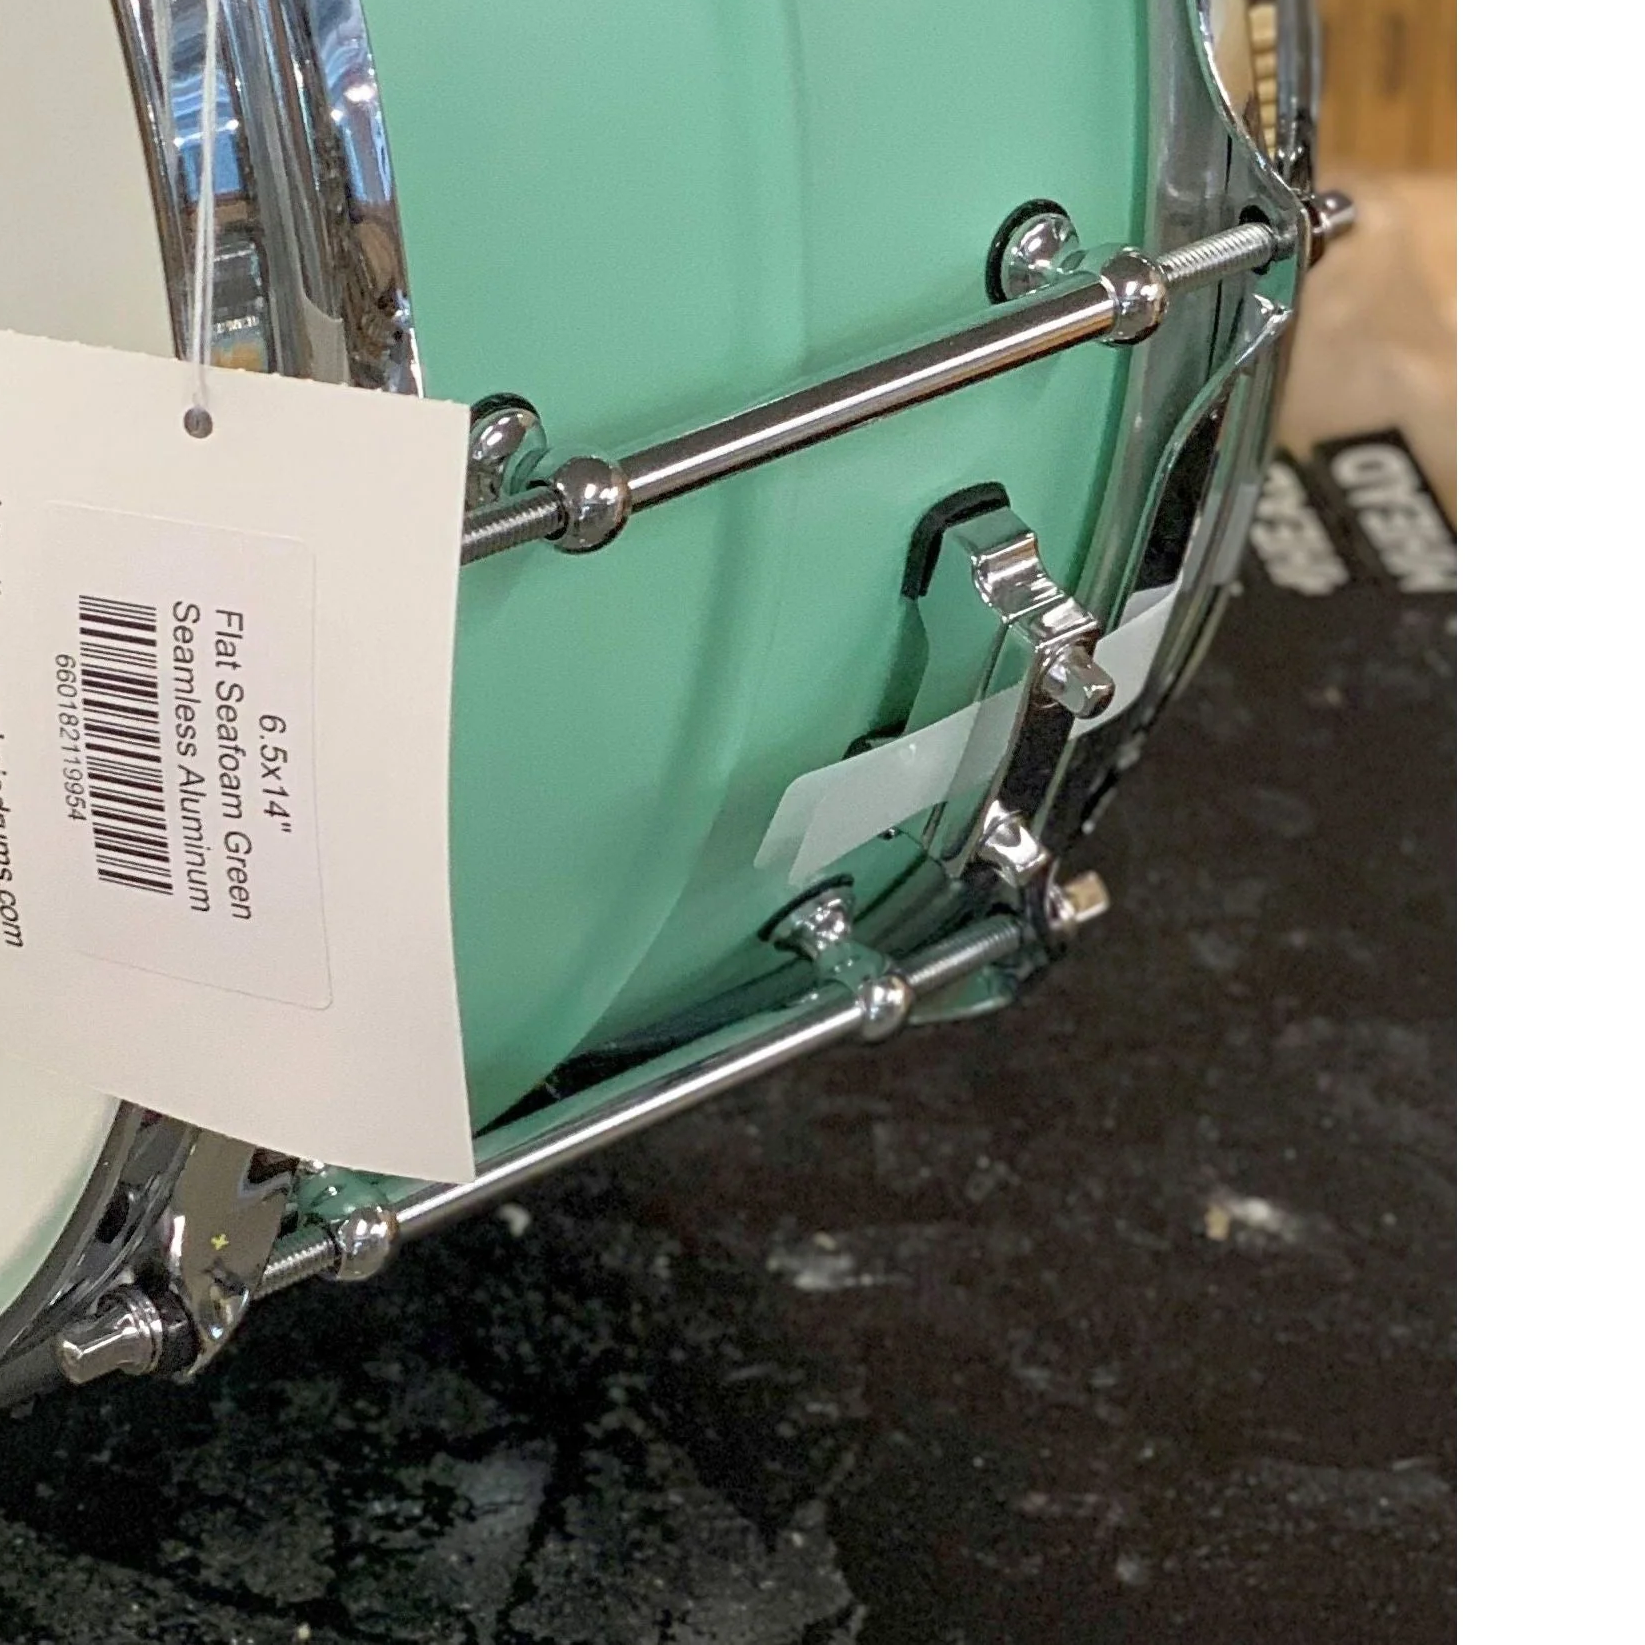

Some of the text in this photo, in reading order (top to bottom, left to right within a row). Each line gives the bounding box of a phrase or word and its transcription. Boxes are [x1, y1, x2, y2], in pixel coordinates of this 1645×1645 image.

[54, 654, 87, 823] 660182119954
[172, 600, 212, 913] Seamless Aluminum
[214, 609, 253, 921] Flat Seafoam Green
[258, 713, 293, 834] 6.5x14"
